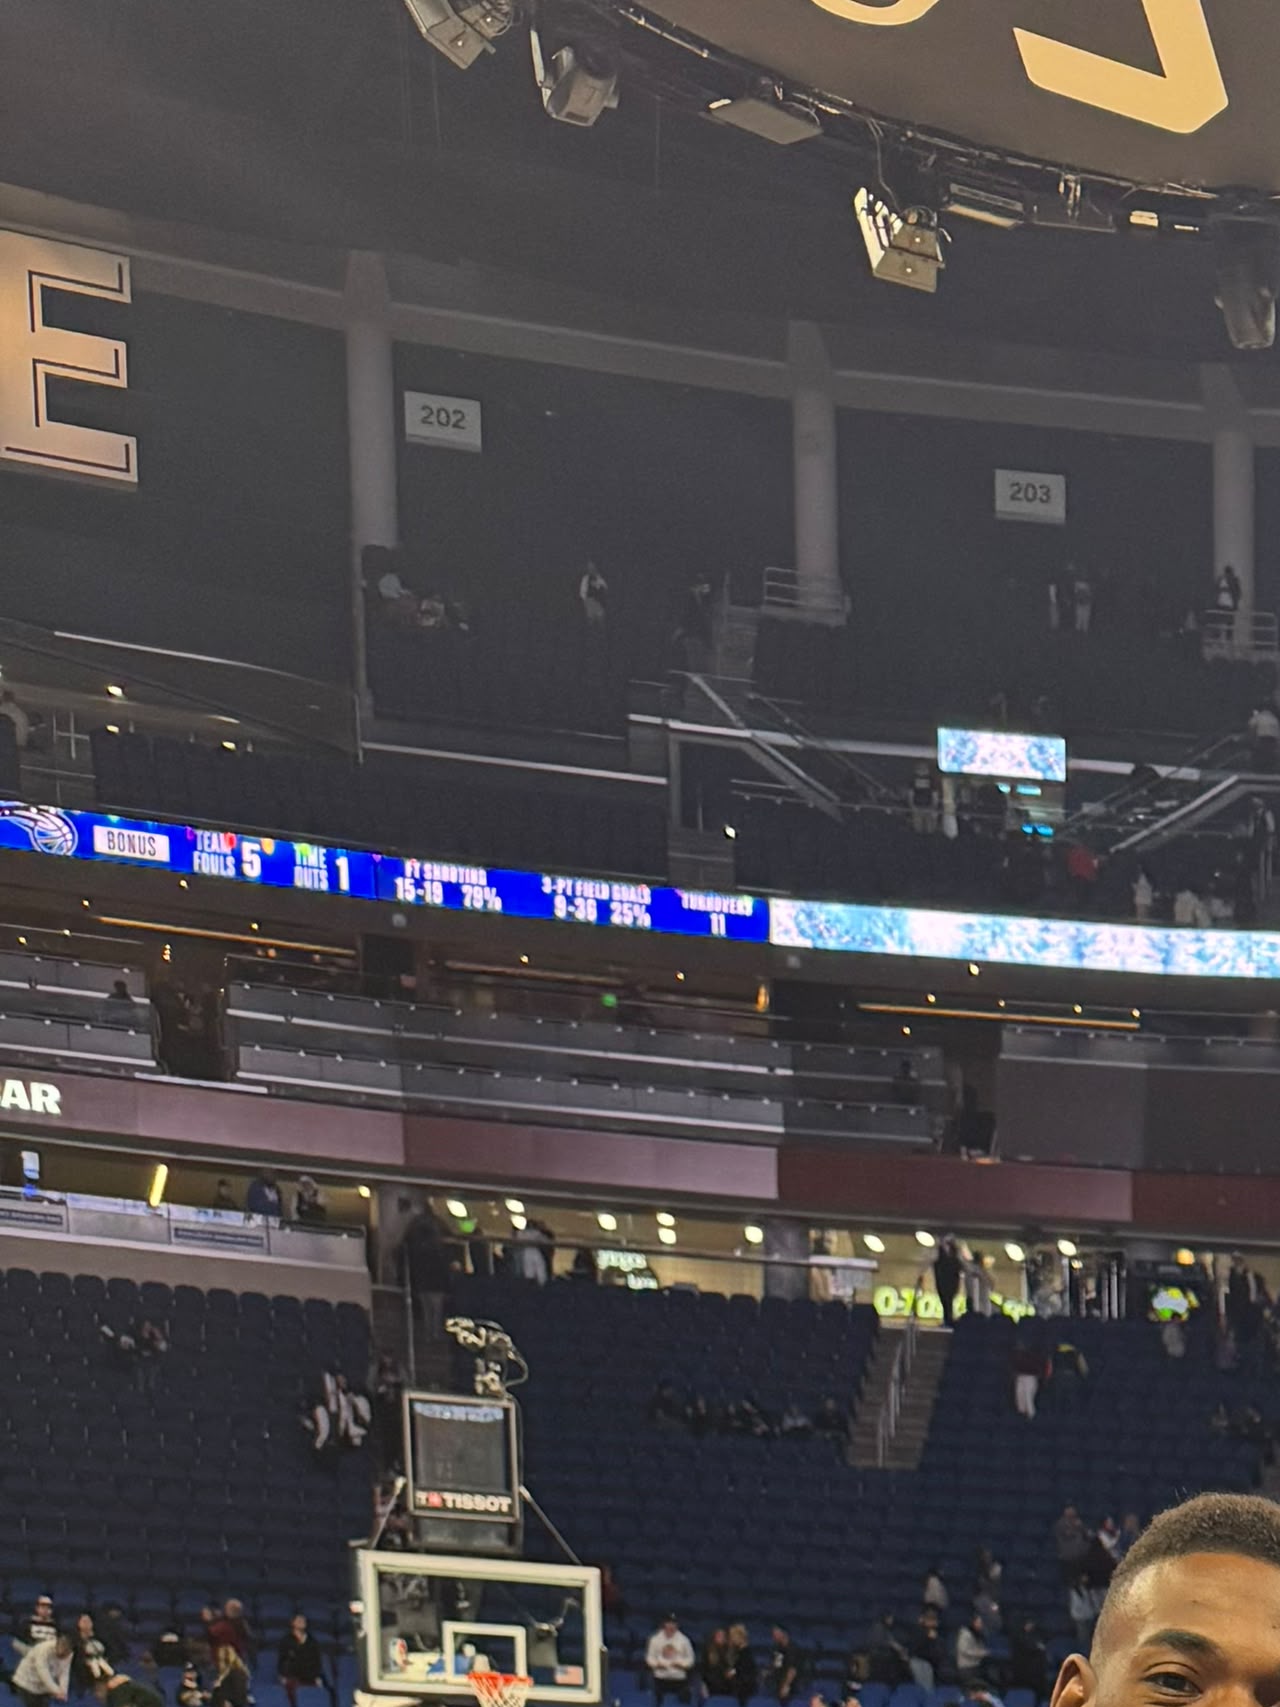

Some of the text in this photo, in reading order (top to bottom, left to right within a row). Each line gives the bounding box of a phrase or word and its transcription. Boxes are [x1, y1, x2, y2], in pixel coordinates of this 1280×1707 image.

[420, 405, 467, 431] 202
[1009, 481, 1051, 507] 203
[107, 829, 157, 857] BONUS
[192, 850, 236, 877] FOULS
[241, 841, 262, 879] 5
[335, 856, 350, 892] 1
[441, 1492, 513, 1513] TISSOT
